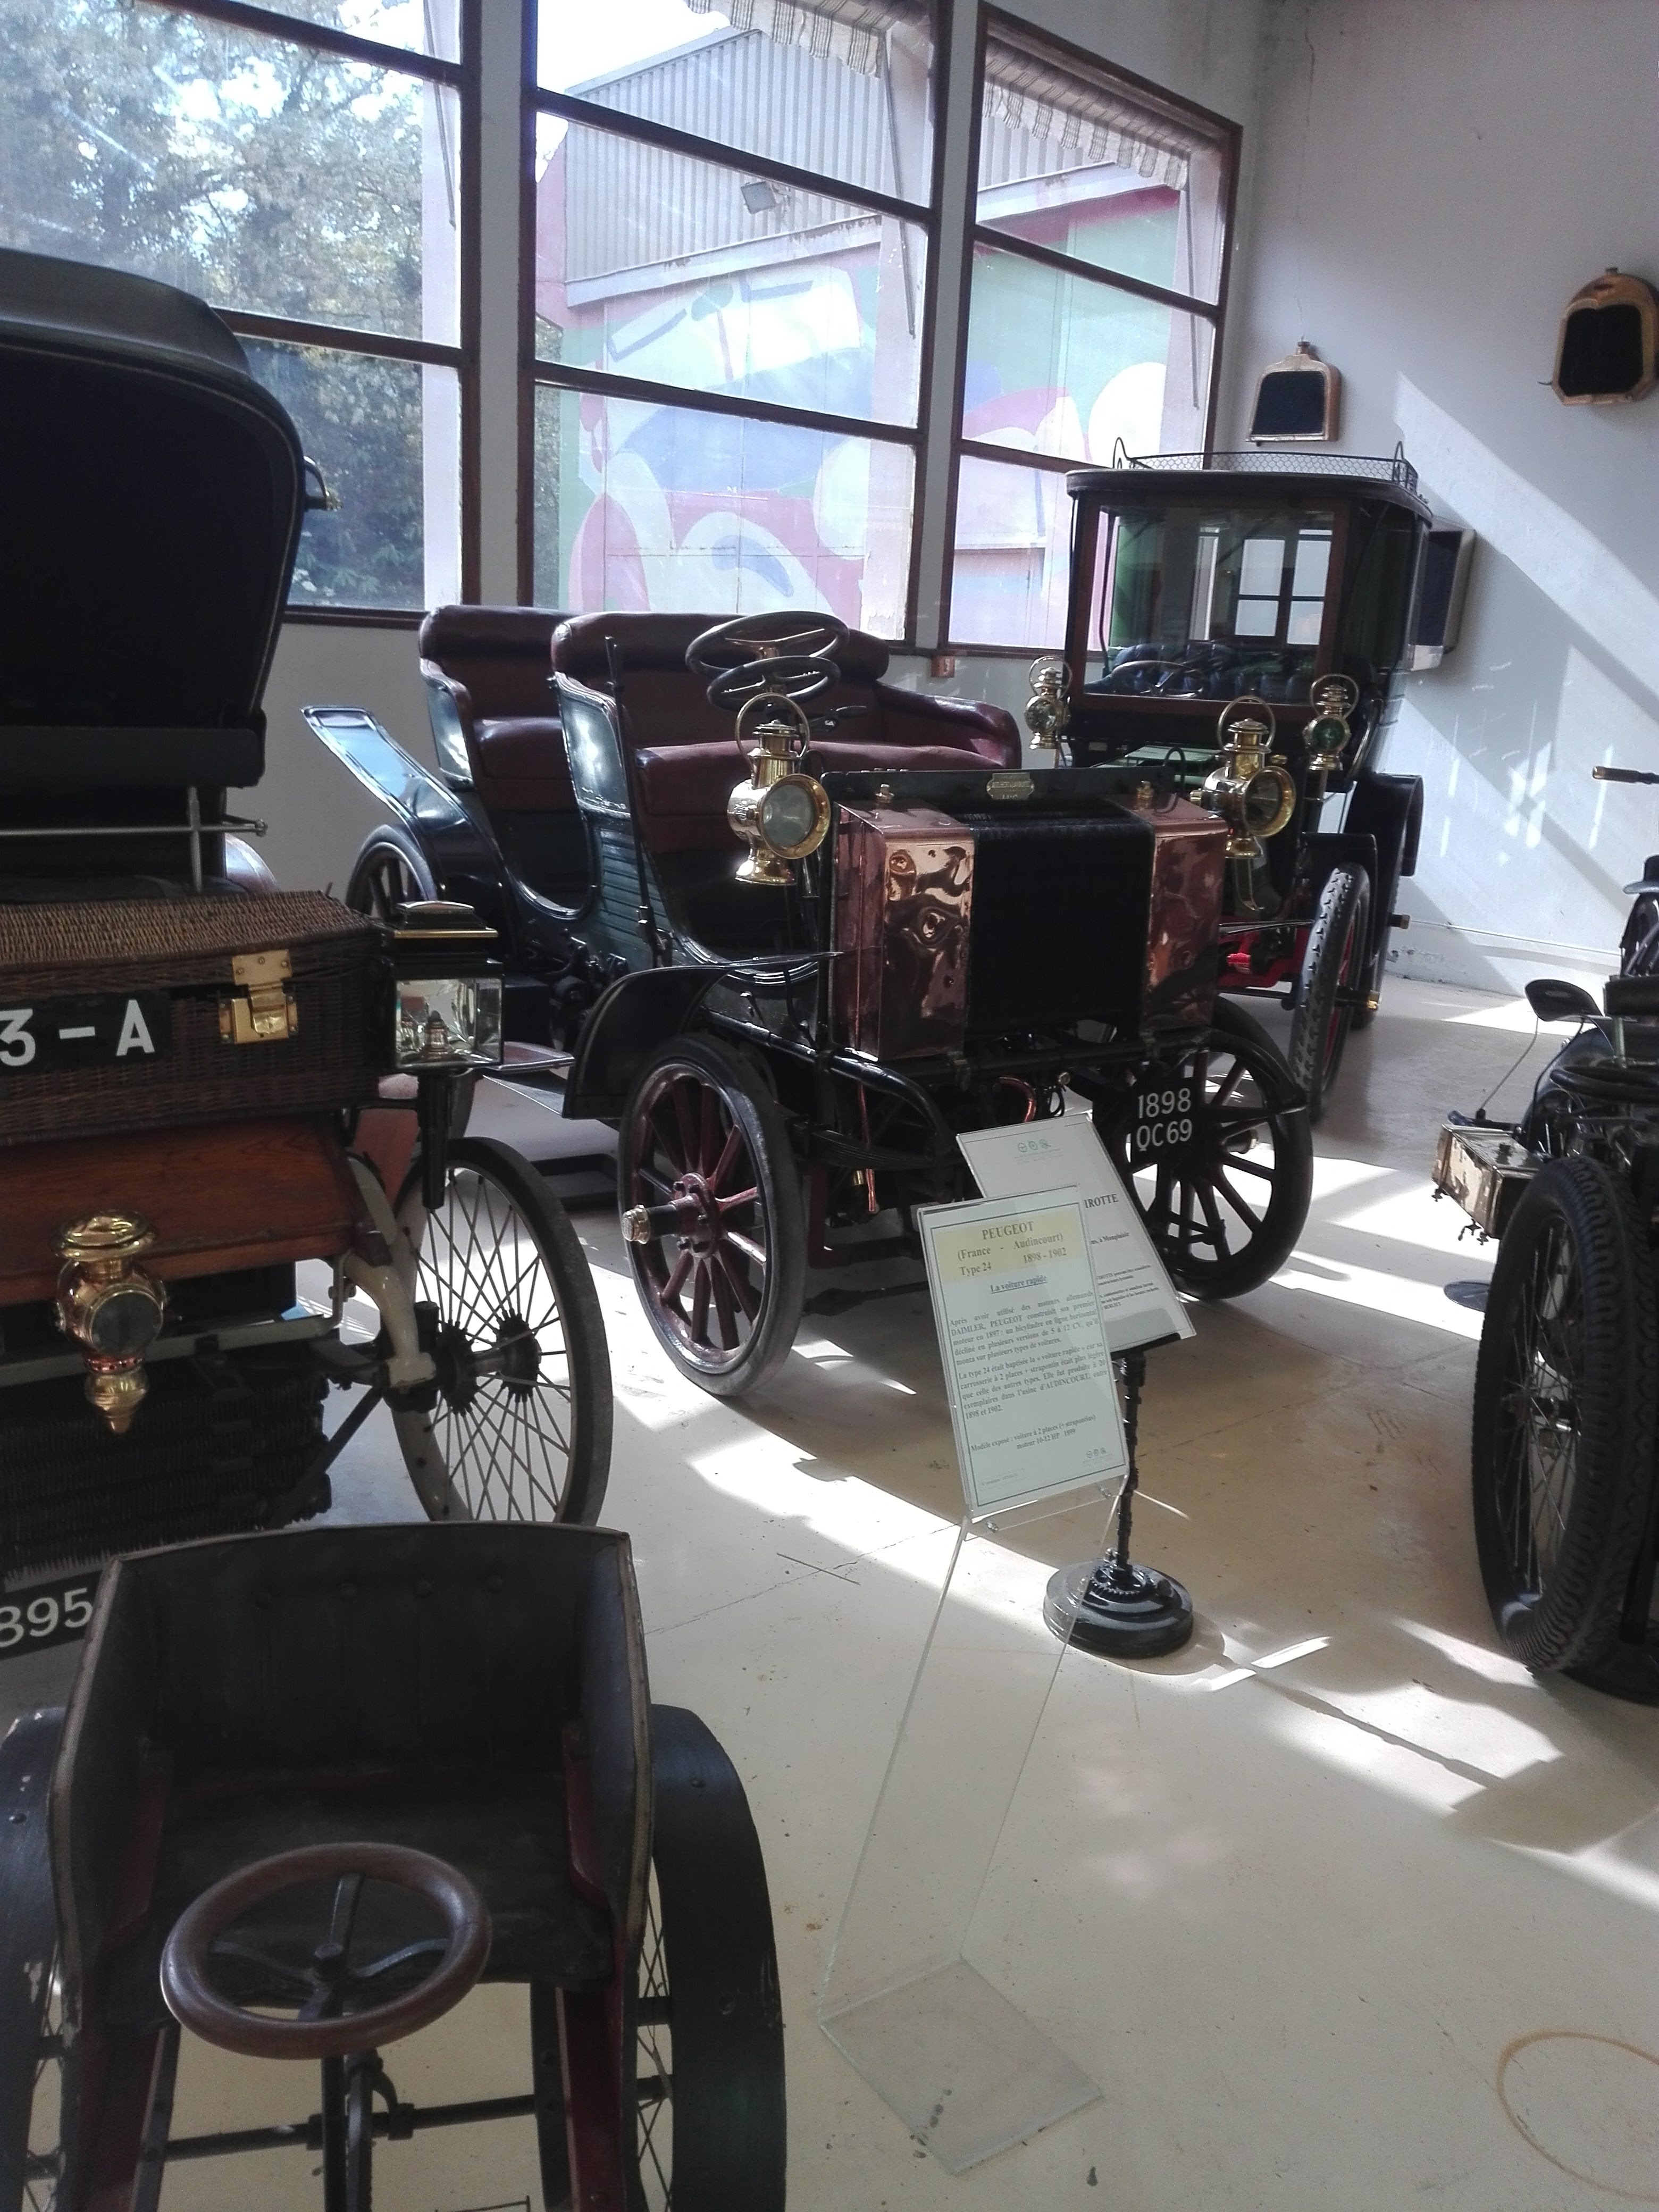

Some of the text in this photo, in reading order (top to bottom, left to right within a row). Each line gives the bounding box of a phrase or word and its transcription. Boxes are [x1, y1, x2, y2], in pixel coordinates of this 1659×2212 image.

[1138, 1088, 1191, 1119] 1898
[982, 1222, 1033, 1239] PEUGEOT
[957, 1249, 990, 1260] (France
[1014, 1234, 1063, 1248] Audincourt)
[959, 1267, 981, 1276] Type
[982, 1262, 992, 1271] 24
[1023, 1253, 1041, 1262] 1898
[1048, 1247, 1067, 1258] 1902
[1026, 1276, 1046, 1285] rapide
[990, 1315, 1022, 1327] PEUGEOT
[985, 1330, 999, 1338] 1897
[1015, 1322, 1043, 1331] bicylindre
[987, 1339, 1014, 1349] plusieurs
[987, 1349, 1013, 1360] plusieurs
[960, 1378, 992, 1389] carrosserie
[1005, 1371, 1023, 1380] places
[1030, 1362, 1059, 1372] strapontin
[963, 1397, 999, 1409] exemplaires
[965, 1410, 979, 1419] 1898
[1042, 1426, 1058, 1434] places
[1016, 1440, 1035, 1449] moteur
